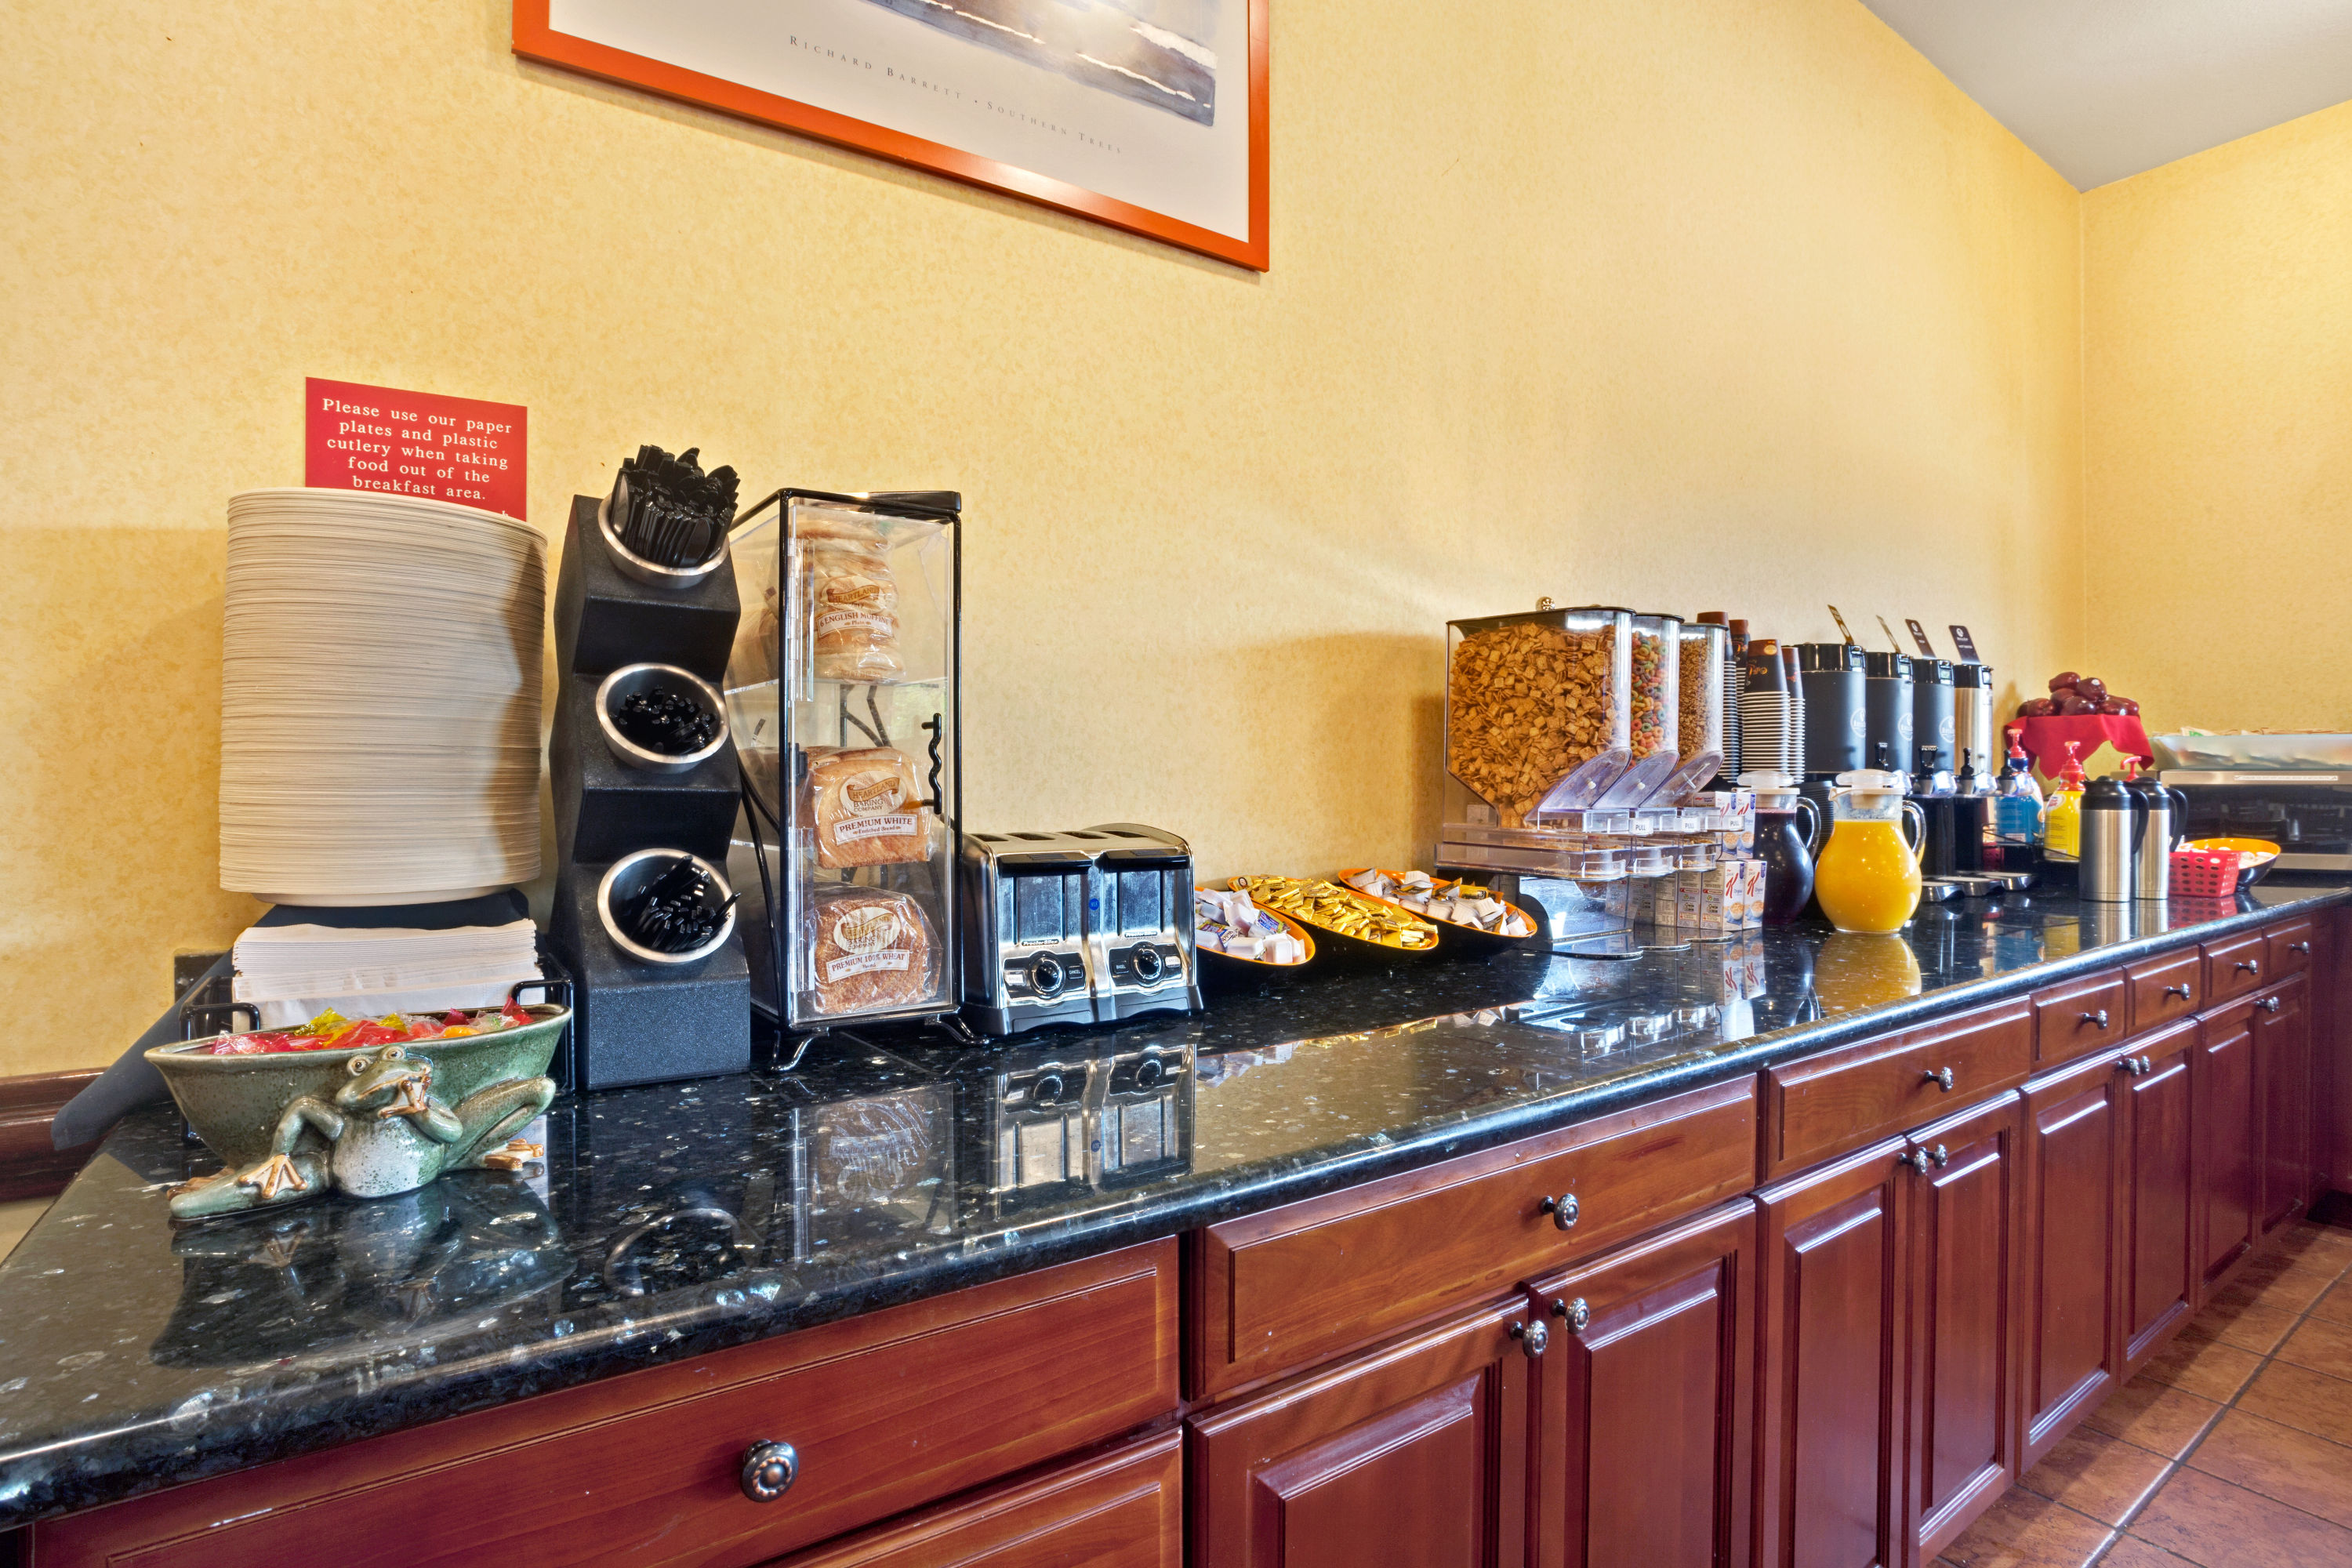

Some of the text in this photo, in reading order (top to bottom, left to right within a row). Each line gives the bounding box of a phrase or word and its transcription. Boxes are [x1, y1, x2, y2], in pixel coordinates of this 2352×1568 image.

[322, 397, 512, 434] Please use our paper
[339, 421, 498, 449] plates and plastic
[327, 437, 508, 470] cutlery when taking
[348, 456, 490, 483] food out of the
[352, 475, 486, 500] breakfast area.
[825, 612, 858, 624] ENGLISH
[852, 779, 895, 800] HEARTLAND
[853, 798, 884, 808] BAKING
[839, 816, 913, 833] PREMIUM WHITE
[832, 956, 862, 971] PREMIUM
